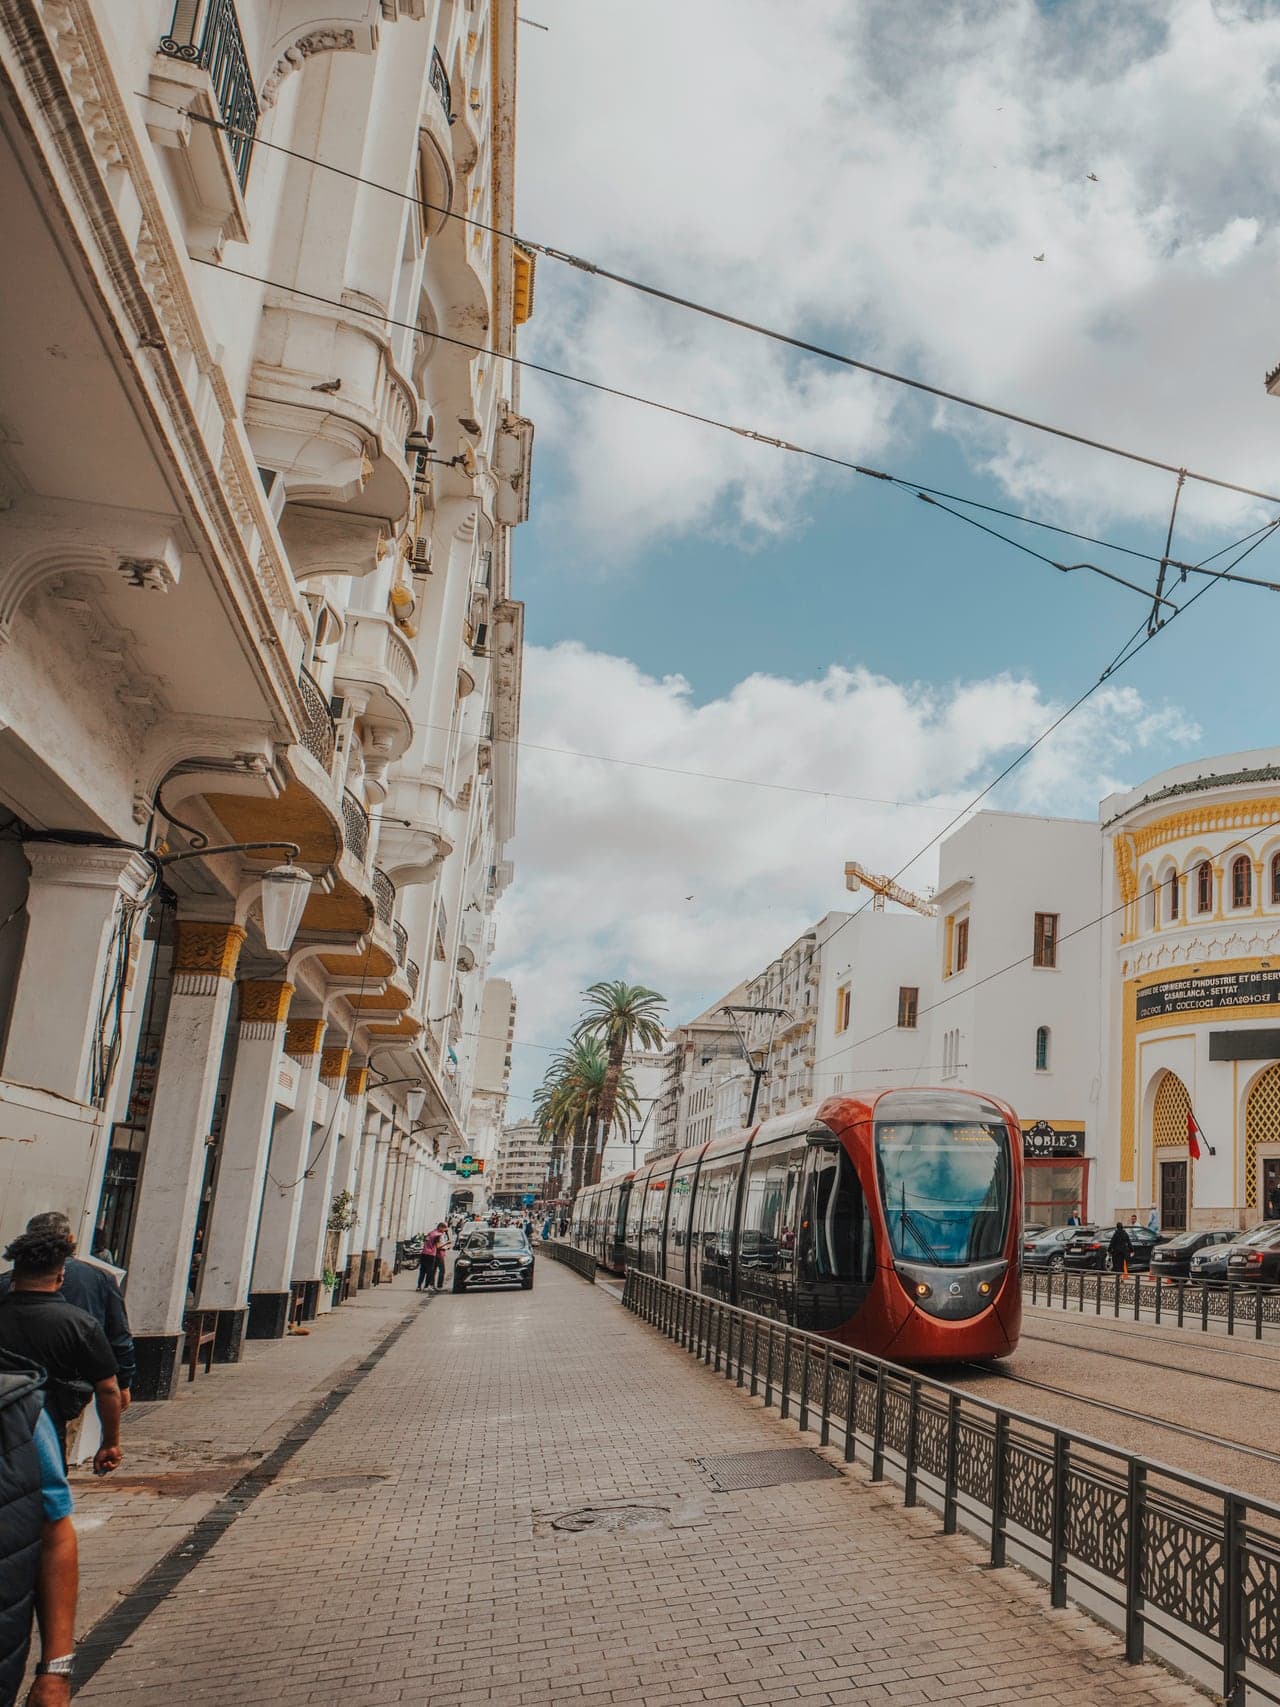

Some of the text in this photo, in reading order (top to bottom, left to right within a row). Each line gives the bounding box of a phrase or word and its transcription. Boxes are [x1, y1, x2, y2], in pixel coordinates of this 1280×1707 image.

[1160, 981, 1191, 993] COMMERCE
[1239, 974, 1250, 983] ET
[1251, 973, 1261, 982] DE
[1164, 989, 1205, 1001] CASABLANCA
[1210, 985, 1238, 996] SETTAT
